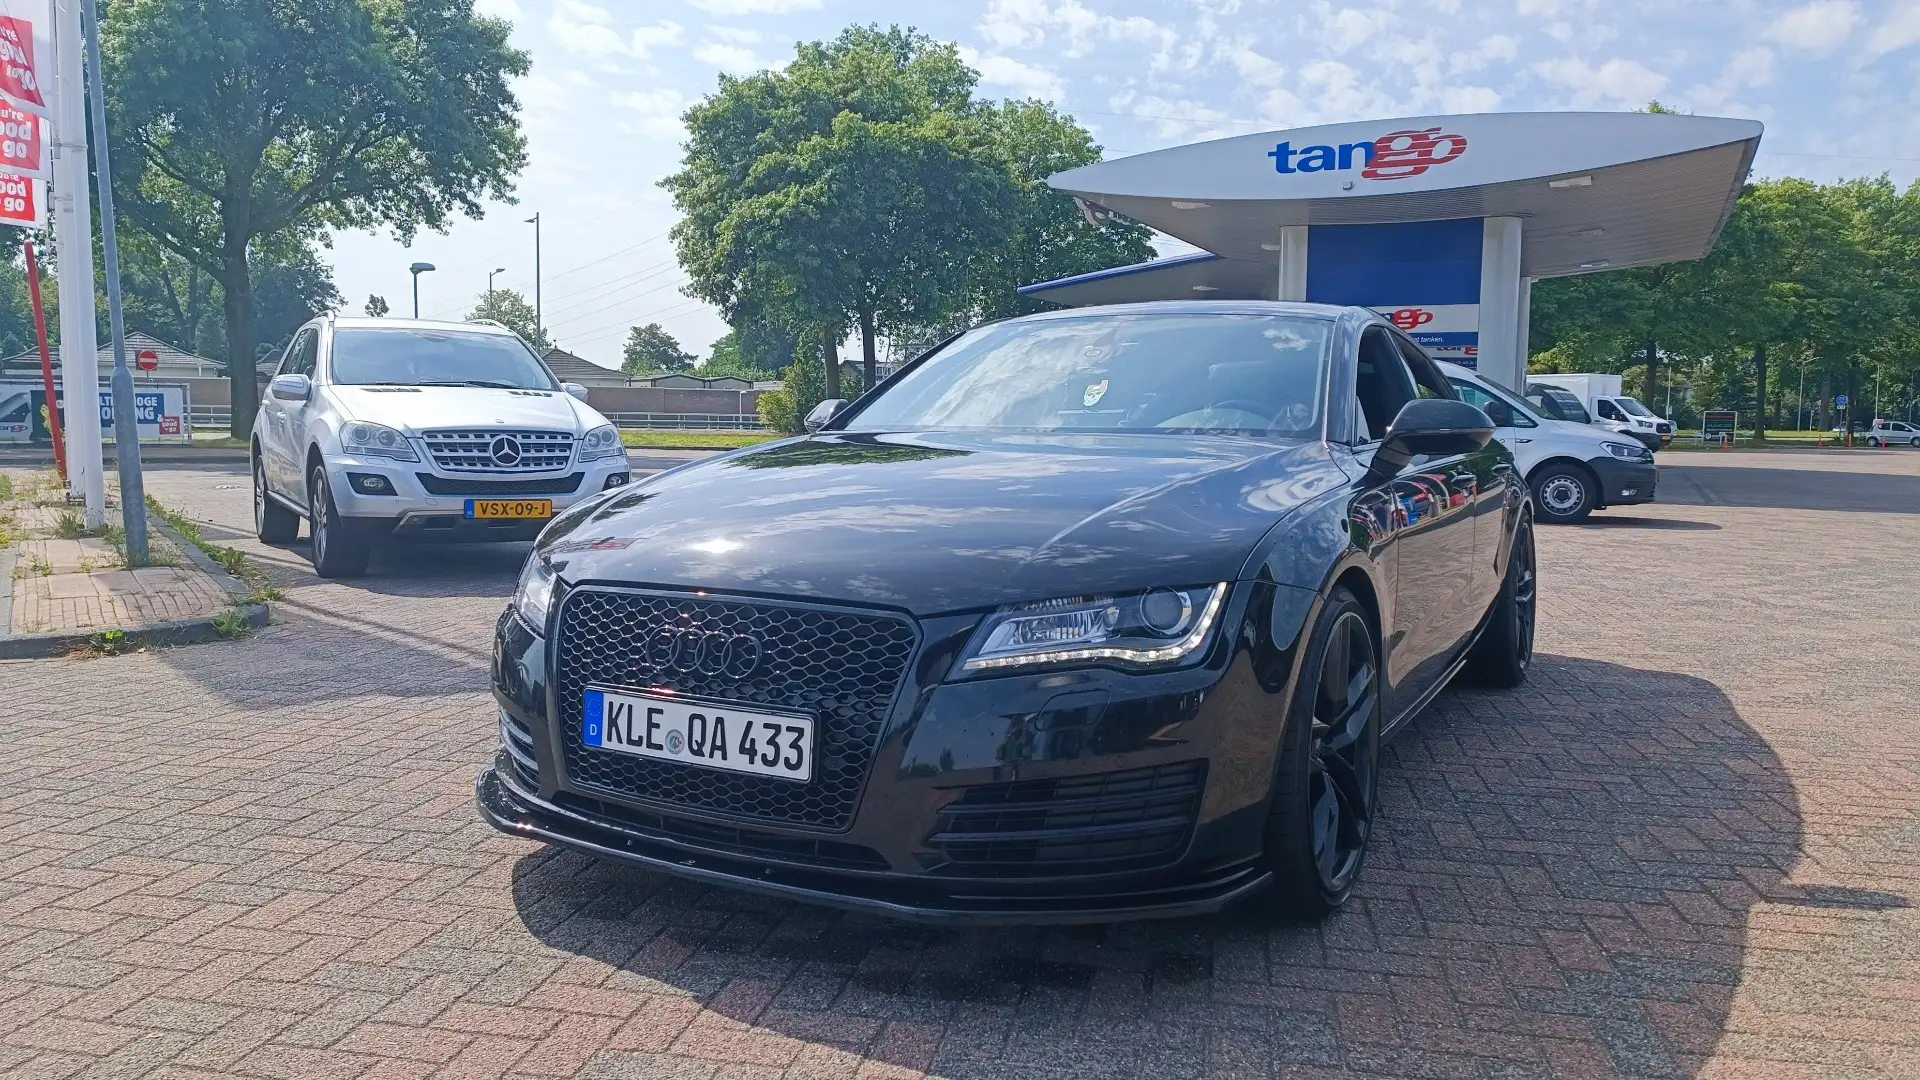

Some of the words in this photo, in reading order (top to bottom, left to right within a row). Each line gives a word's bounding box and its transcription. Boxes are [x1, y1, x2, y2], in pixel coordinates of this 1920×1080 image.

[0, 107, 24, 121] u're
[2, 140, 27, 158] go
[1267, 126, 1467, 181] tango
[4, 197, 25, 212] go
[137, 396, 158, 407] OGE
[480, 502, 546, 516] VSX-09-J
[589, 724, 597, 736] D
[606, 701, 664, 751] KLE
[687, 712, 728, 761] QA
[738, 720, 806, 771] 433
